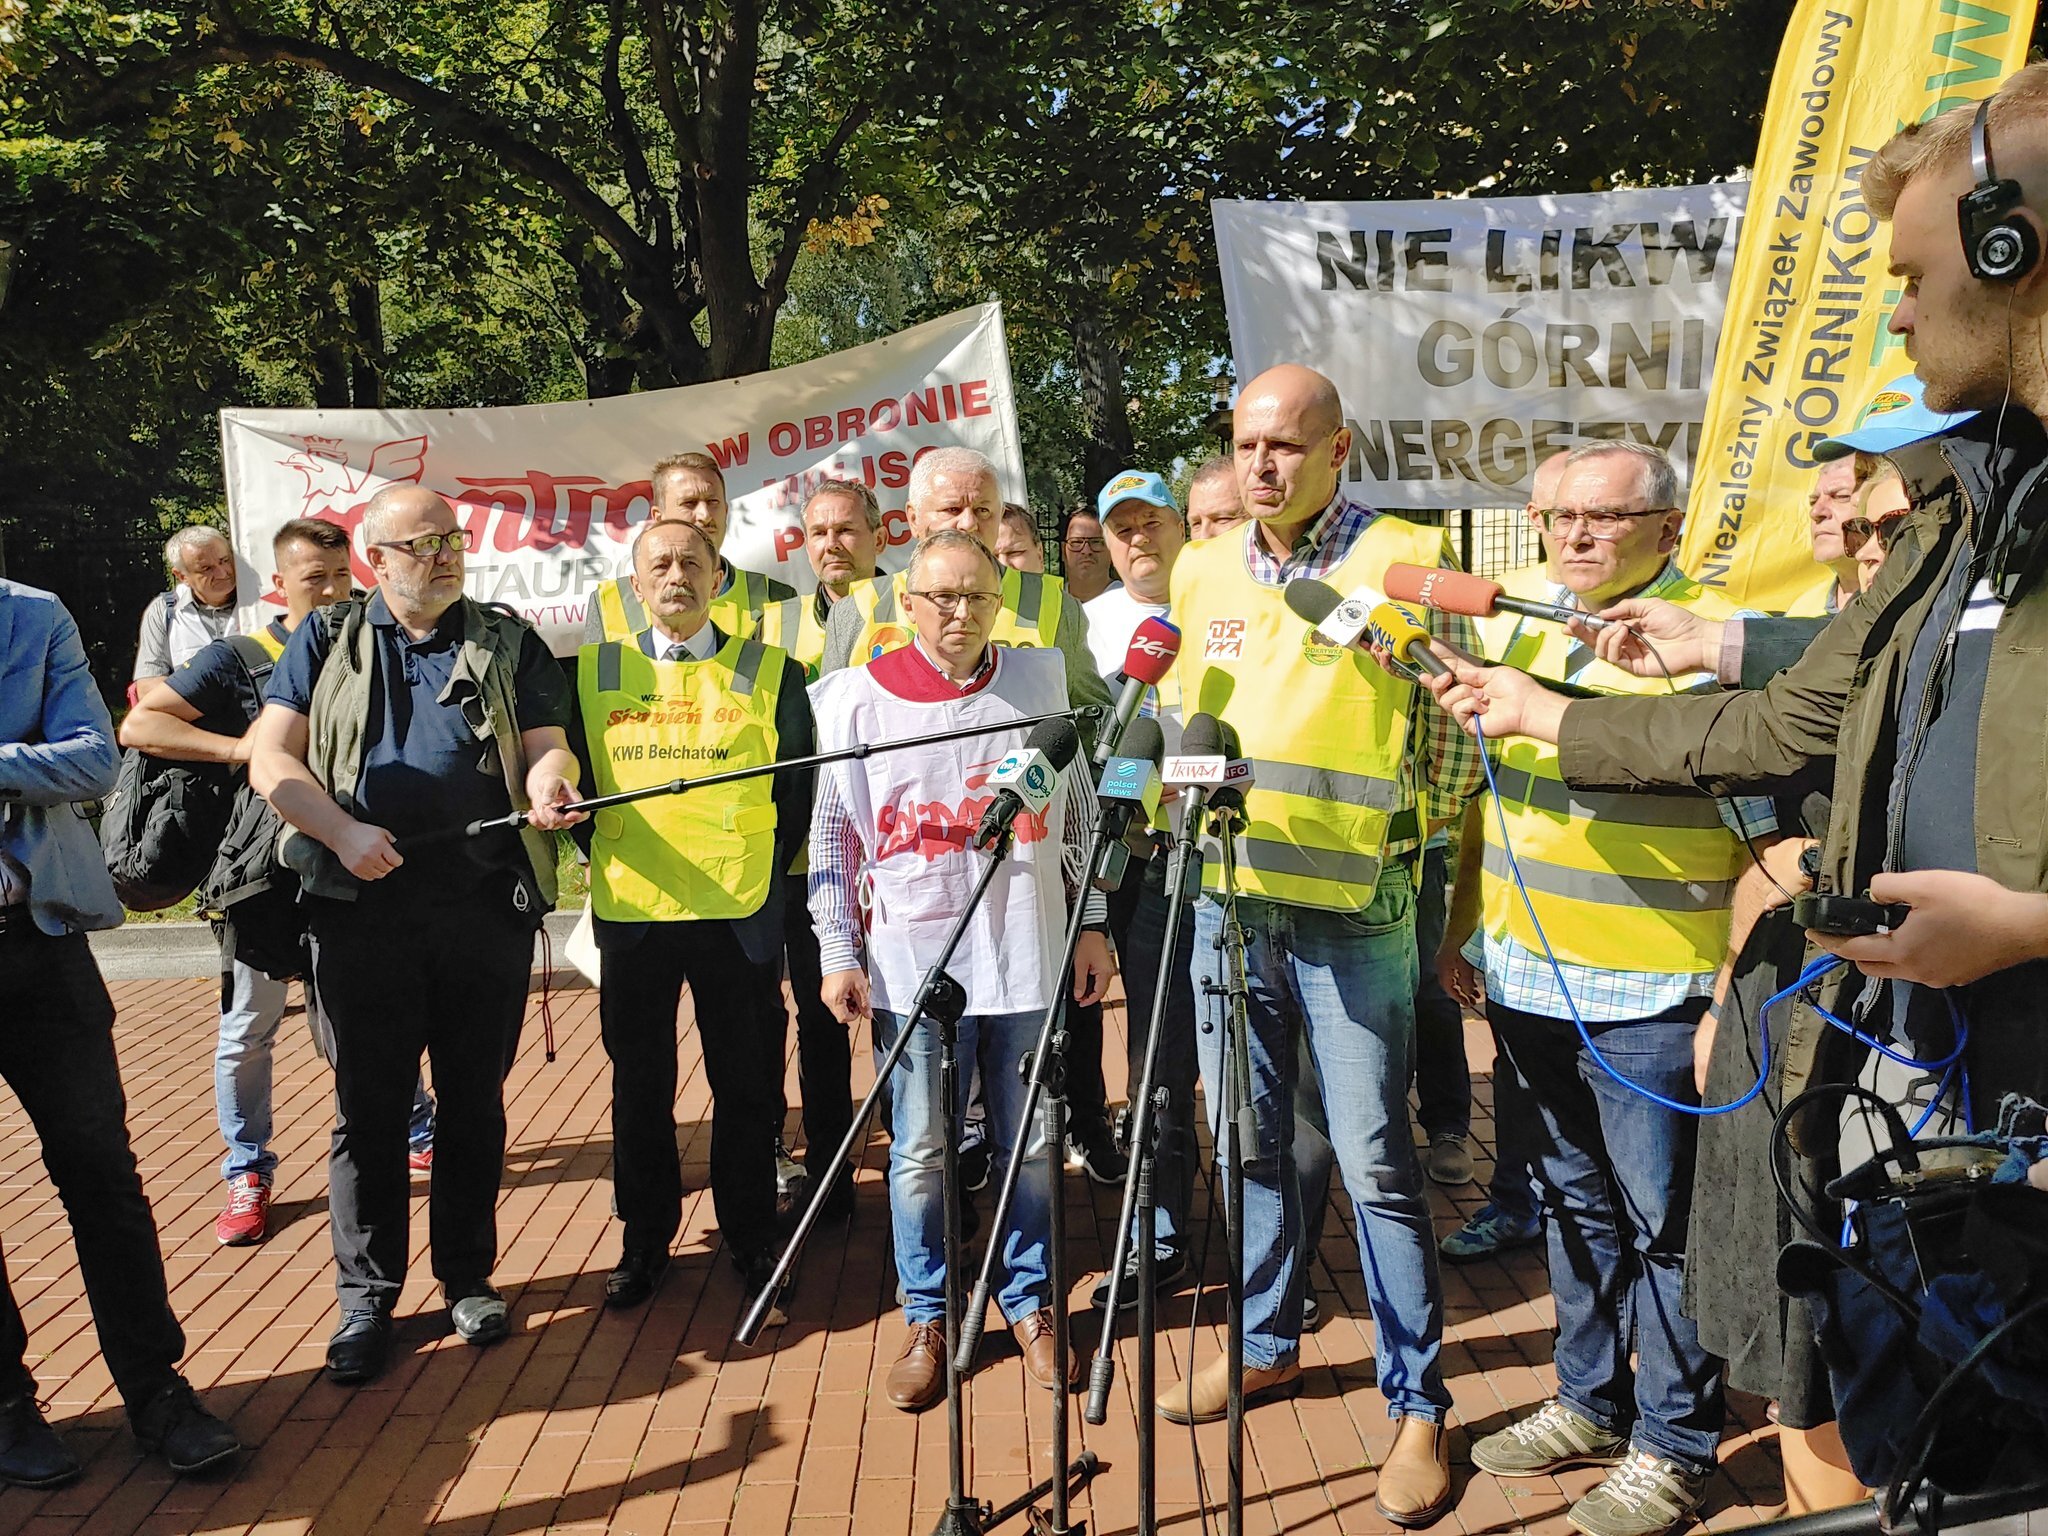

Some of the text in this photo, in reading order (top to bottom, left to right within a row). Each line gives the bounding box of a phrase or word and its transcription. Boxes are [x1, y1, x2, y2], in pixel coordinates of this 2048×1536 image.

[1316, 227, 1454, 293] NIE
[1699, 9, 1853, 587] Niezależny Związek Zawodowy
[1417, 307, 1721, 390] GÓRNI
[706, 379, 992, 469] W OBRONIE
[641, 694, 664, 702] WZZ
[606, 706, 703, 728] Sierpień
[612, 743, 730, 762] KWB Bełchatów
[1106, 779, 1138, 790] polsat
[1107, 787, 1133, 797] news
